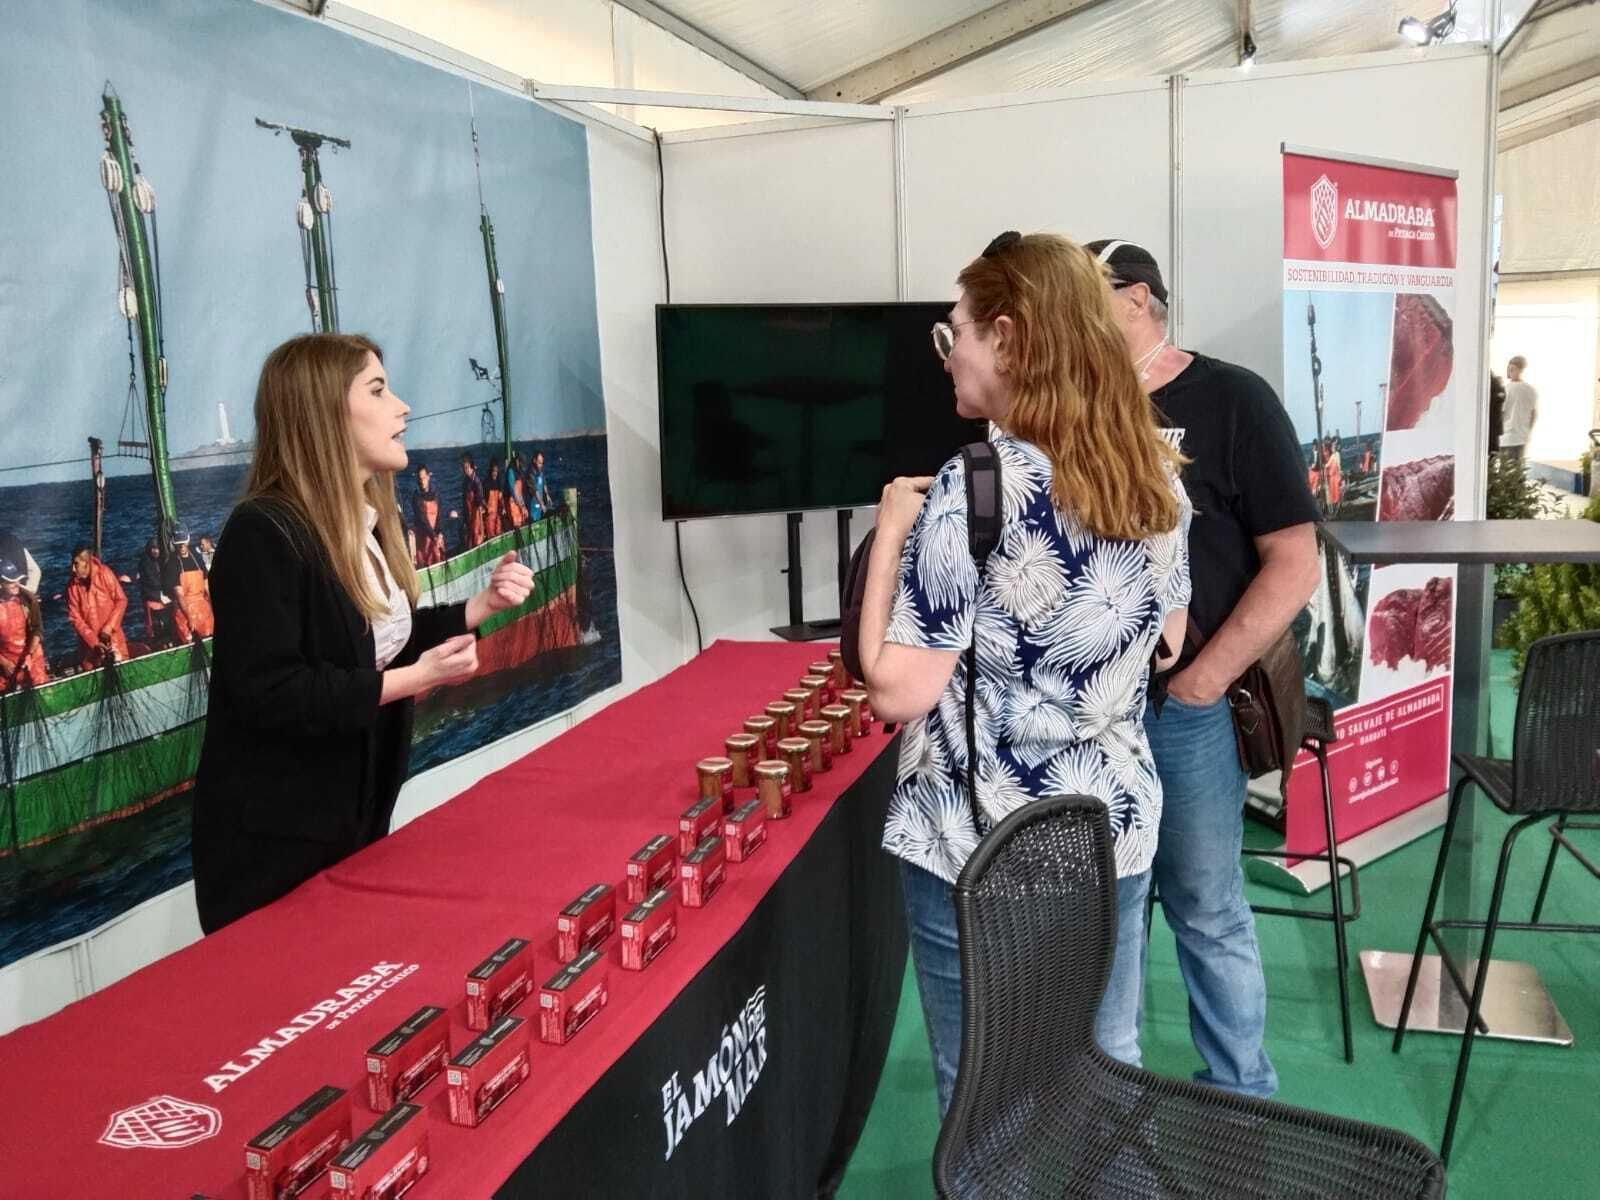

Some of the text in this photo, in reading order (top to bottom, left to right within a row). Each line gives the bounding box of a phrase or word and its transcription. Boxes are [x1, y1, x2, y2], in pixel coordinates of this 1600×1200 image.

[1344, 199, 1435, 227] ALMADRABA
[1407, 273, 1453, 288] VANGUARDIA
[1348, 713, 1383, 737] SALVAJE
[1385, 710, 1395, 723] DE
[1397, 693, 1441, 718] ALMADRABA
[203, 961, 404, 1093] ALMADRABA
[661, 1071, 682, 1112] EL
[663, 1009, 748, 1161] JAMÓN
[724, 1026, 768, 1127] MAR
